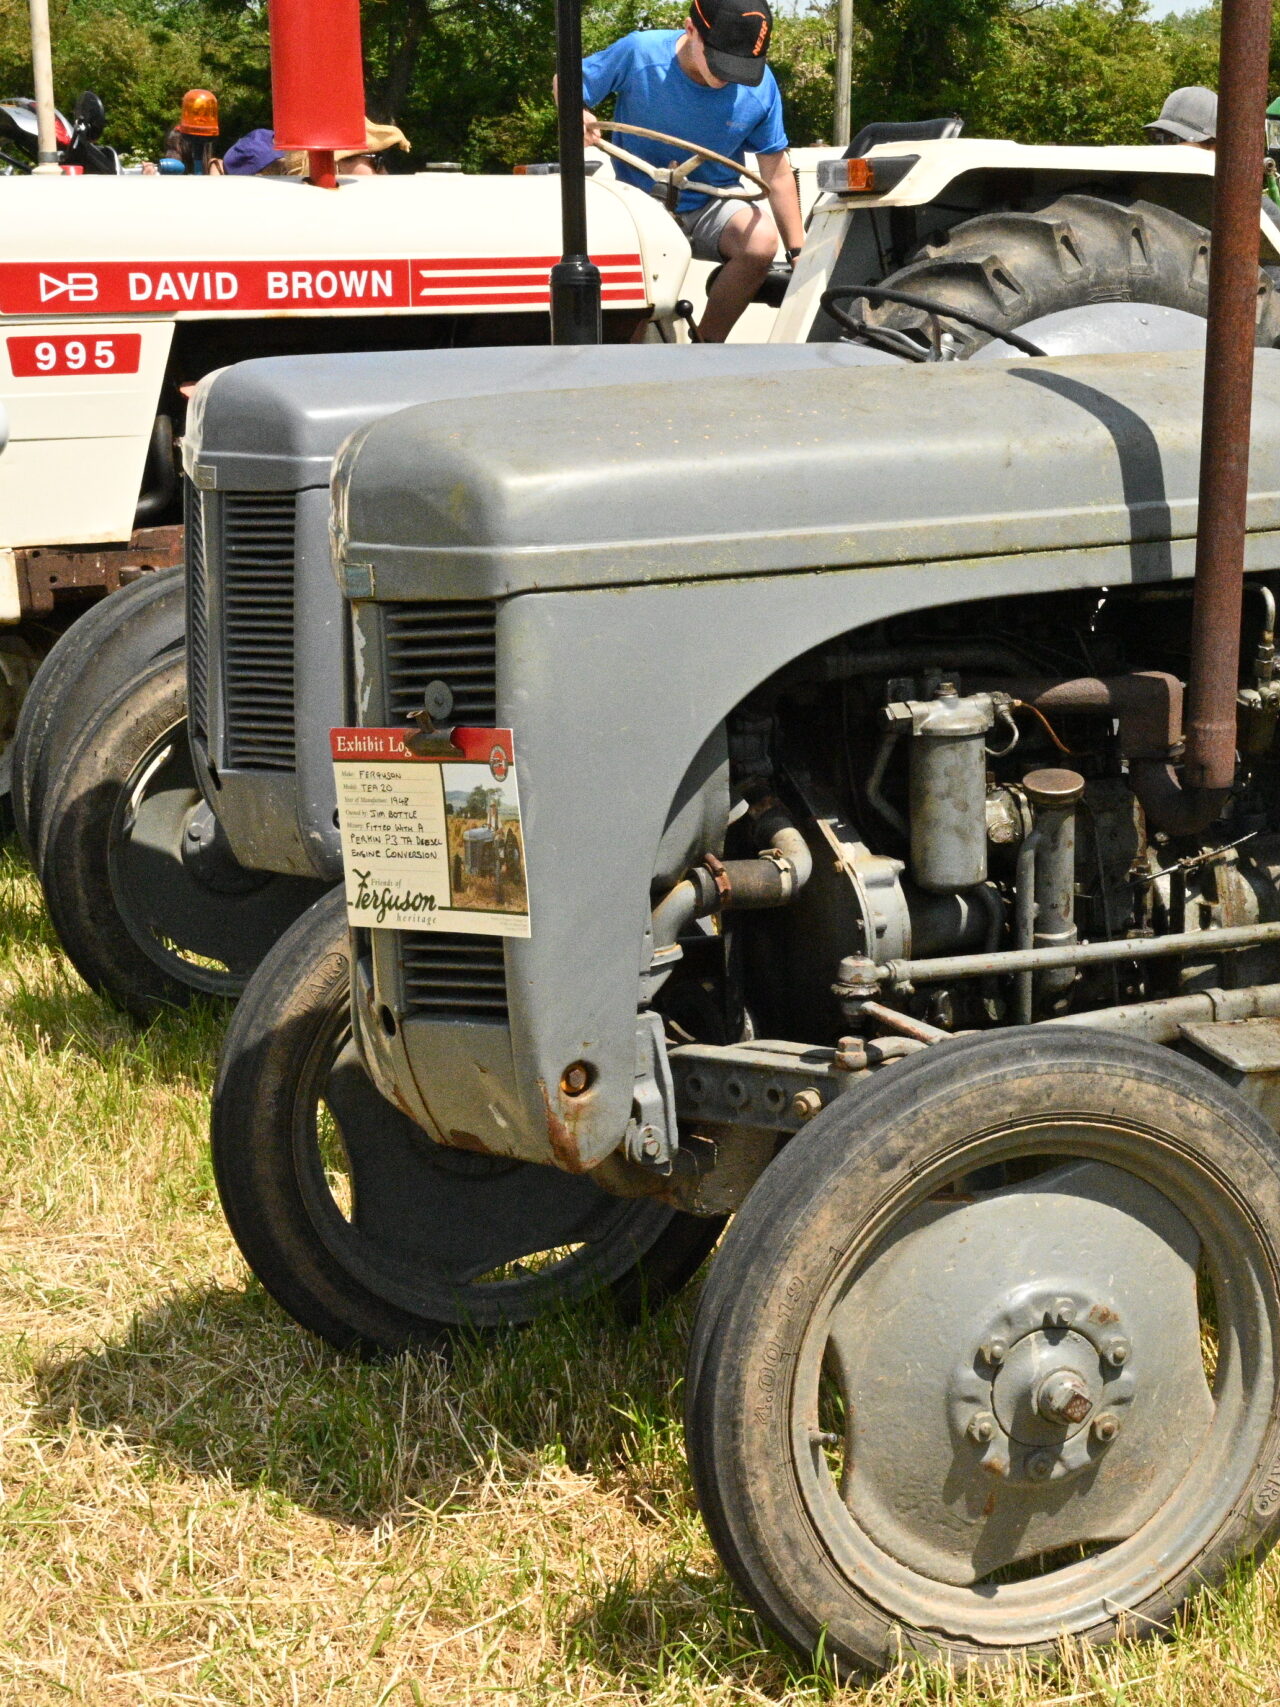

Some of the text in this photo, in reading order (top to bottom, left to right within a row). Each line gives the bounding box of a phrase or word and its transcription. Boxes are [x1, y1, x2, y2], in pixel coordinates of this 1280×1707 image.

[129, 272, 238, 301] DAVID
[267, 270, 393, 299] BROWN
[34, 341, 115, 371] 995
[336, 736, 384, 752] Exhibit
[359, 771, 402, 780] FERGUSON
[361, 784, 378, 792] TEA
[380, 783, 393, 792] 20
[390, 797, 409, 805] 1948
[388, 811, 418, 819] BOTTLE
[418, 823, 424, 832] A
[350, 833, 381, 844] PERKIN
[351, 848, 438, 859] ENGINE CONVERSION
[371, 878, 393, 887] Friends
[352, 868, 437, 923] Ferguson
[397, 912, 437, 925] heritage
